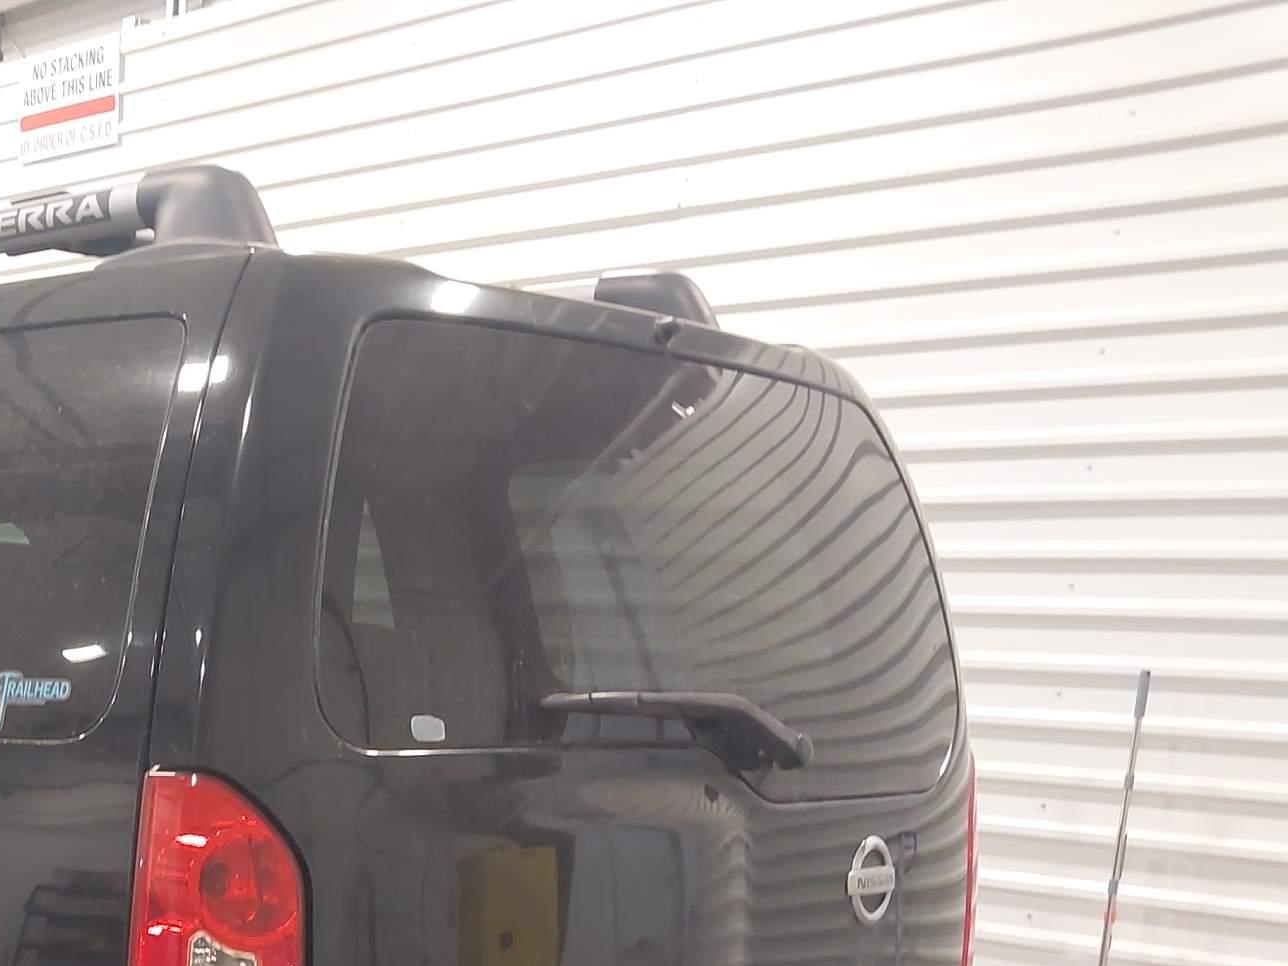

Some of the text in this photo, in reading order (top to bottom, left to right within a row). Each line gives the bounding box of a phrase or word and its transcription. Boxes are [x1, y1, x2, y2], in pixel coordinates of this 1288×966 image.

[32, 46, 104, 80] NO STACKING
[23, 68, 113, 106] ABOVE THIS LINE
